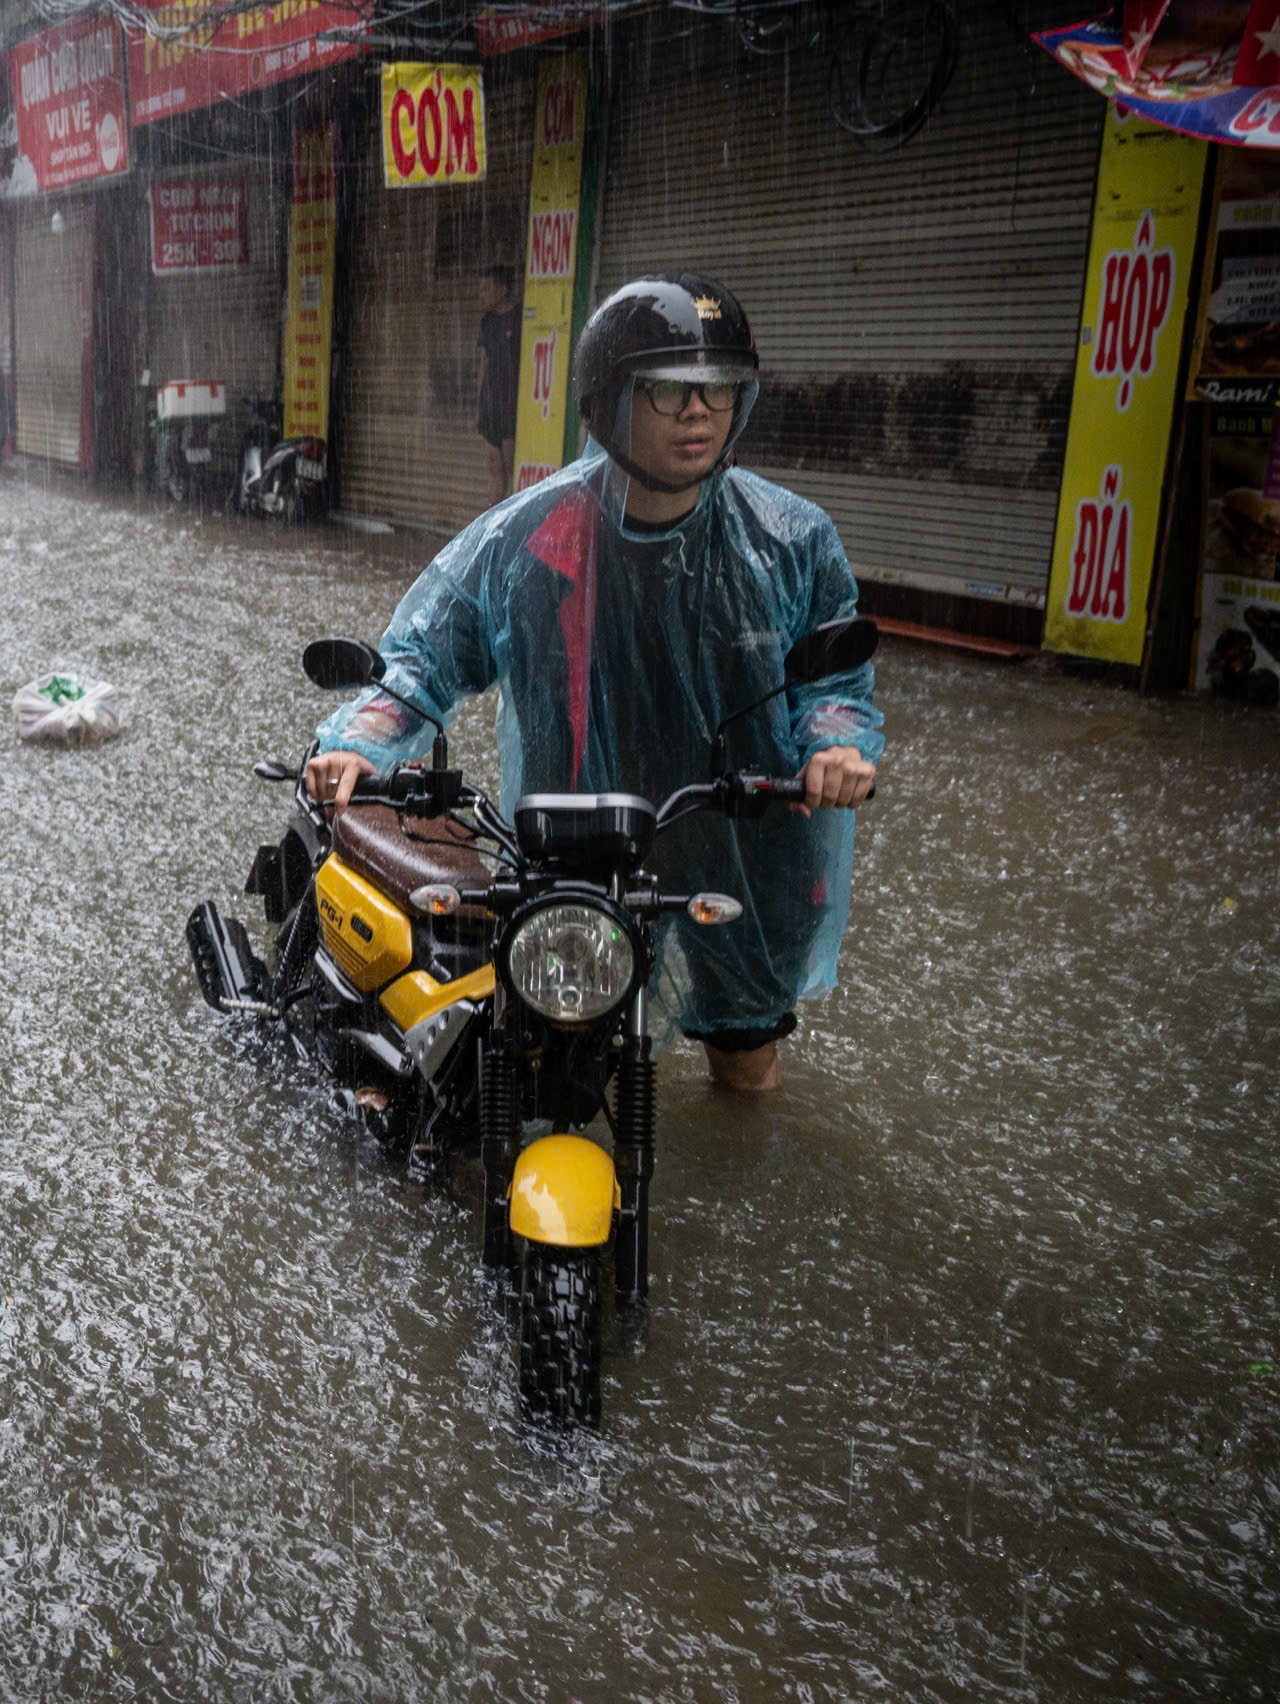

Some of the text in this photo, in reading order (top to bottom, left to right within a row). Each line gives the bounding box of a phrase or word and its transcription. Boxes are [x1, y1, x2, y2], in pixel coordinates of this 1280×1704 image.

[46, 107, 69, 141] VUI
[390, 69, 478, 177] CƠM
[530, 213, 575, 275] NGON
[1093, 214, 1173, 409] HỘP
[533, 330, 557, 419] TỰ
[1068, 468, 1128, 620] ĐĨA
[320, 898, 343, 930] PG-1
